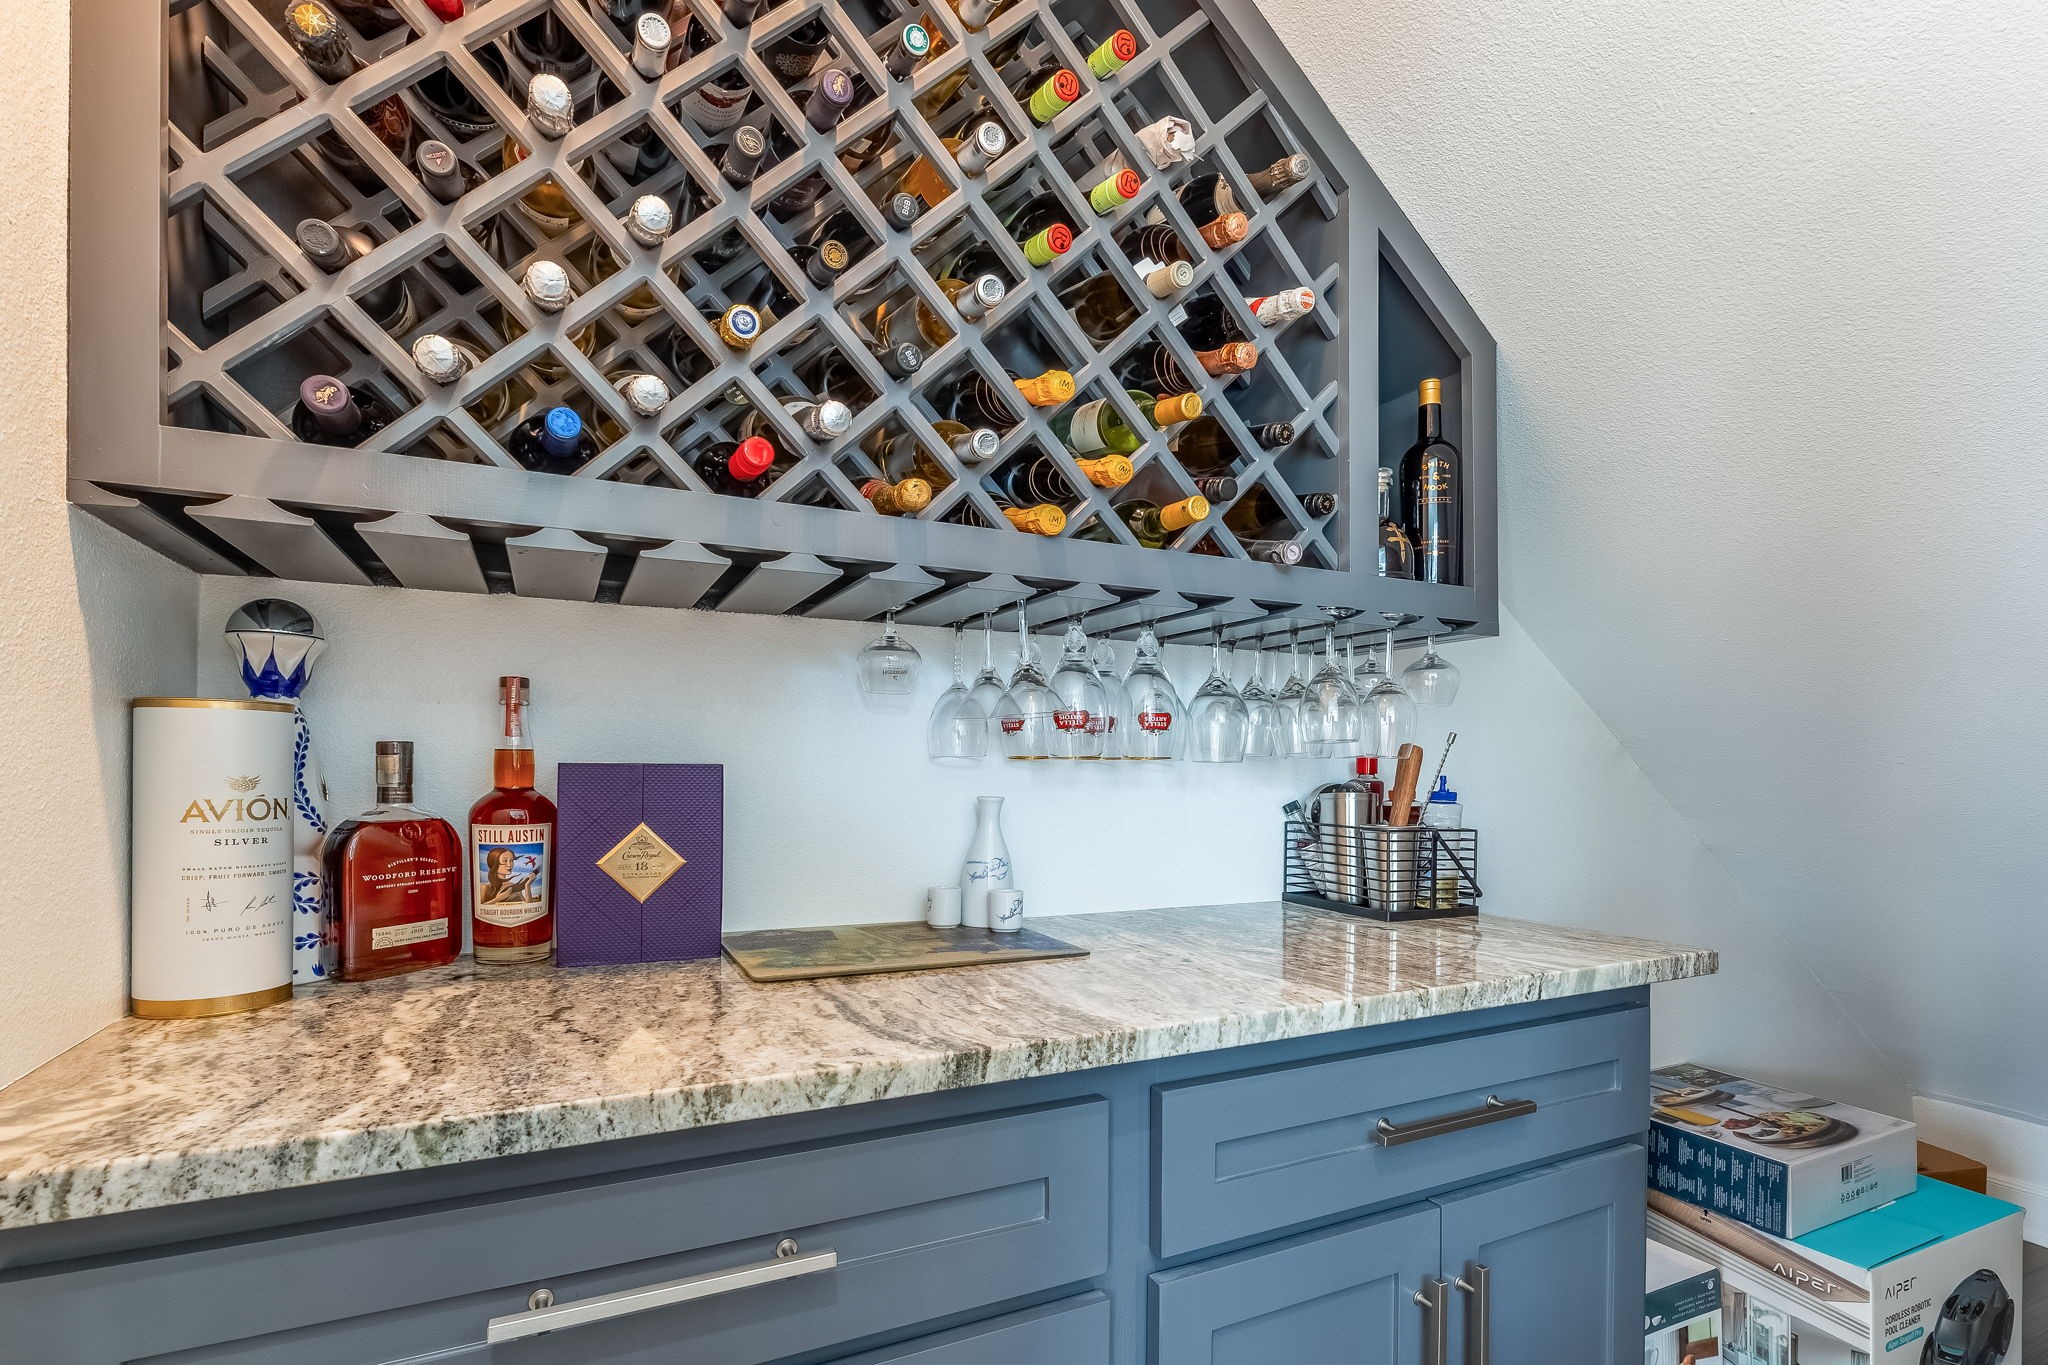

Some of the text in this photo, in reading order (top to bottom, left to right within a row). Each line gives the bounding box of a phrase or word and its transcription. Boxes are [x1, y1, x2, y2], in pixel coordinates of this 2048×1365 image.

[1421, 461, 1450, 471] SMITH
[1432, 471, 1440, 480] &
[1423, 482, 1449, 491] HOOK
[180, 794, 288, 823] AVIÓN
[478, 828, 544, 843] STILL AUSTIN
[214, 837, 268, 846] SILVER
[622, 850, 661, 860] Crown Royal
[635, 861, 649, 871] 18
[233, 871, 267, 879] FORWARD,
[362, 866, 457, 882] WOODFORD RESERVE
[480, 906, 543, 916] STRAIGHT BOURBON WHISKEY
[1884, 1297, 1932, 1326] CORDLESS ROBOTIC
[1884, 1314, 1921, 1338] POOL CLEANER
